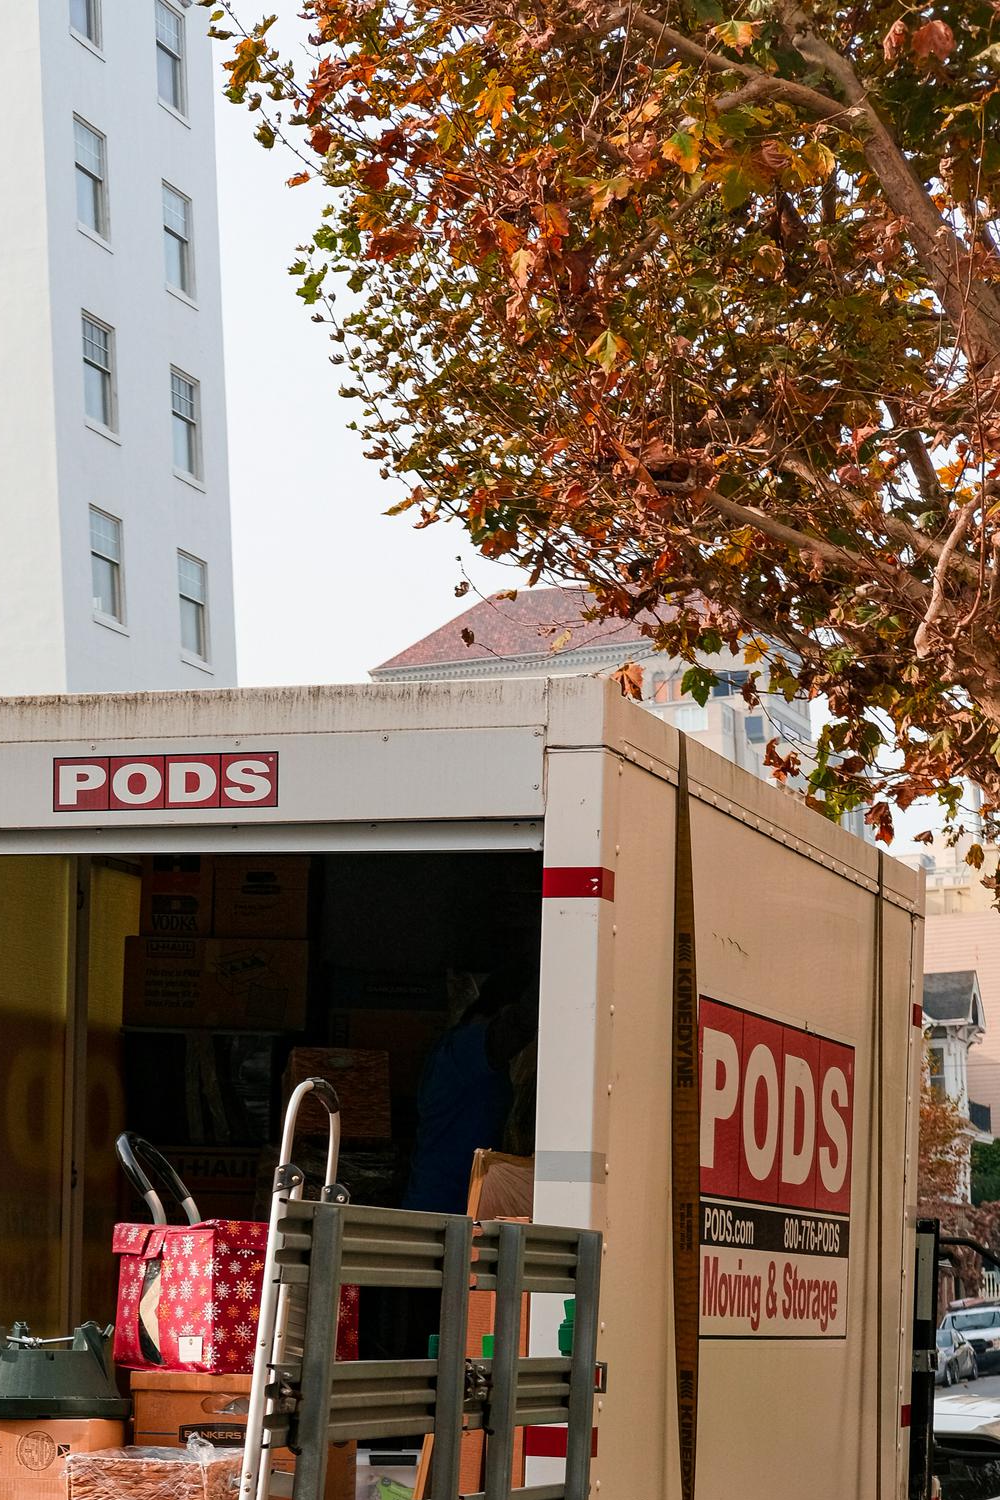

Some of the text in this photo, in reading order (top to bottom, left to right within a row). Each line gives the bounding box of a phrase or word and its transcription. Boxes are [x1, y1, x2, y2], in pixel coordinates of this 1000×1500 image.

[58, 759, 272, 806] PODS
[151, 914, 199, 931] VODKA
[677, 968, 693, 1088] KINEDYNE
[700, 1026, 849, 1194] PODS
[703, 1207, 754, 1245] PODS.com
[783, 1217, 841, 1254] 800-776-PODS
[702, 1255, 838, 1333] Moving & Storage
[184, 1431, 241, 1440] BNKERS
